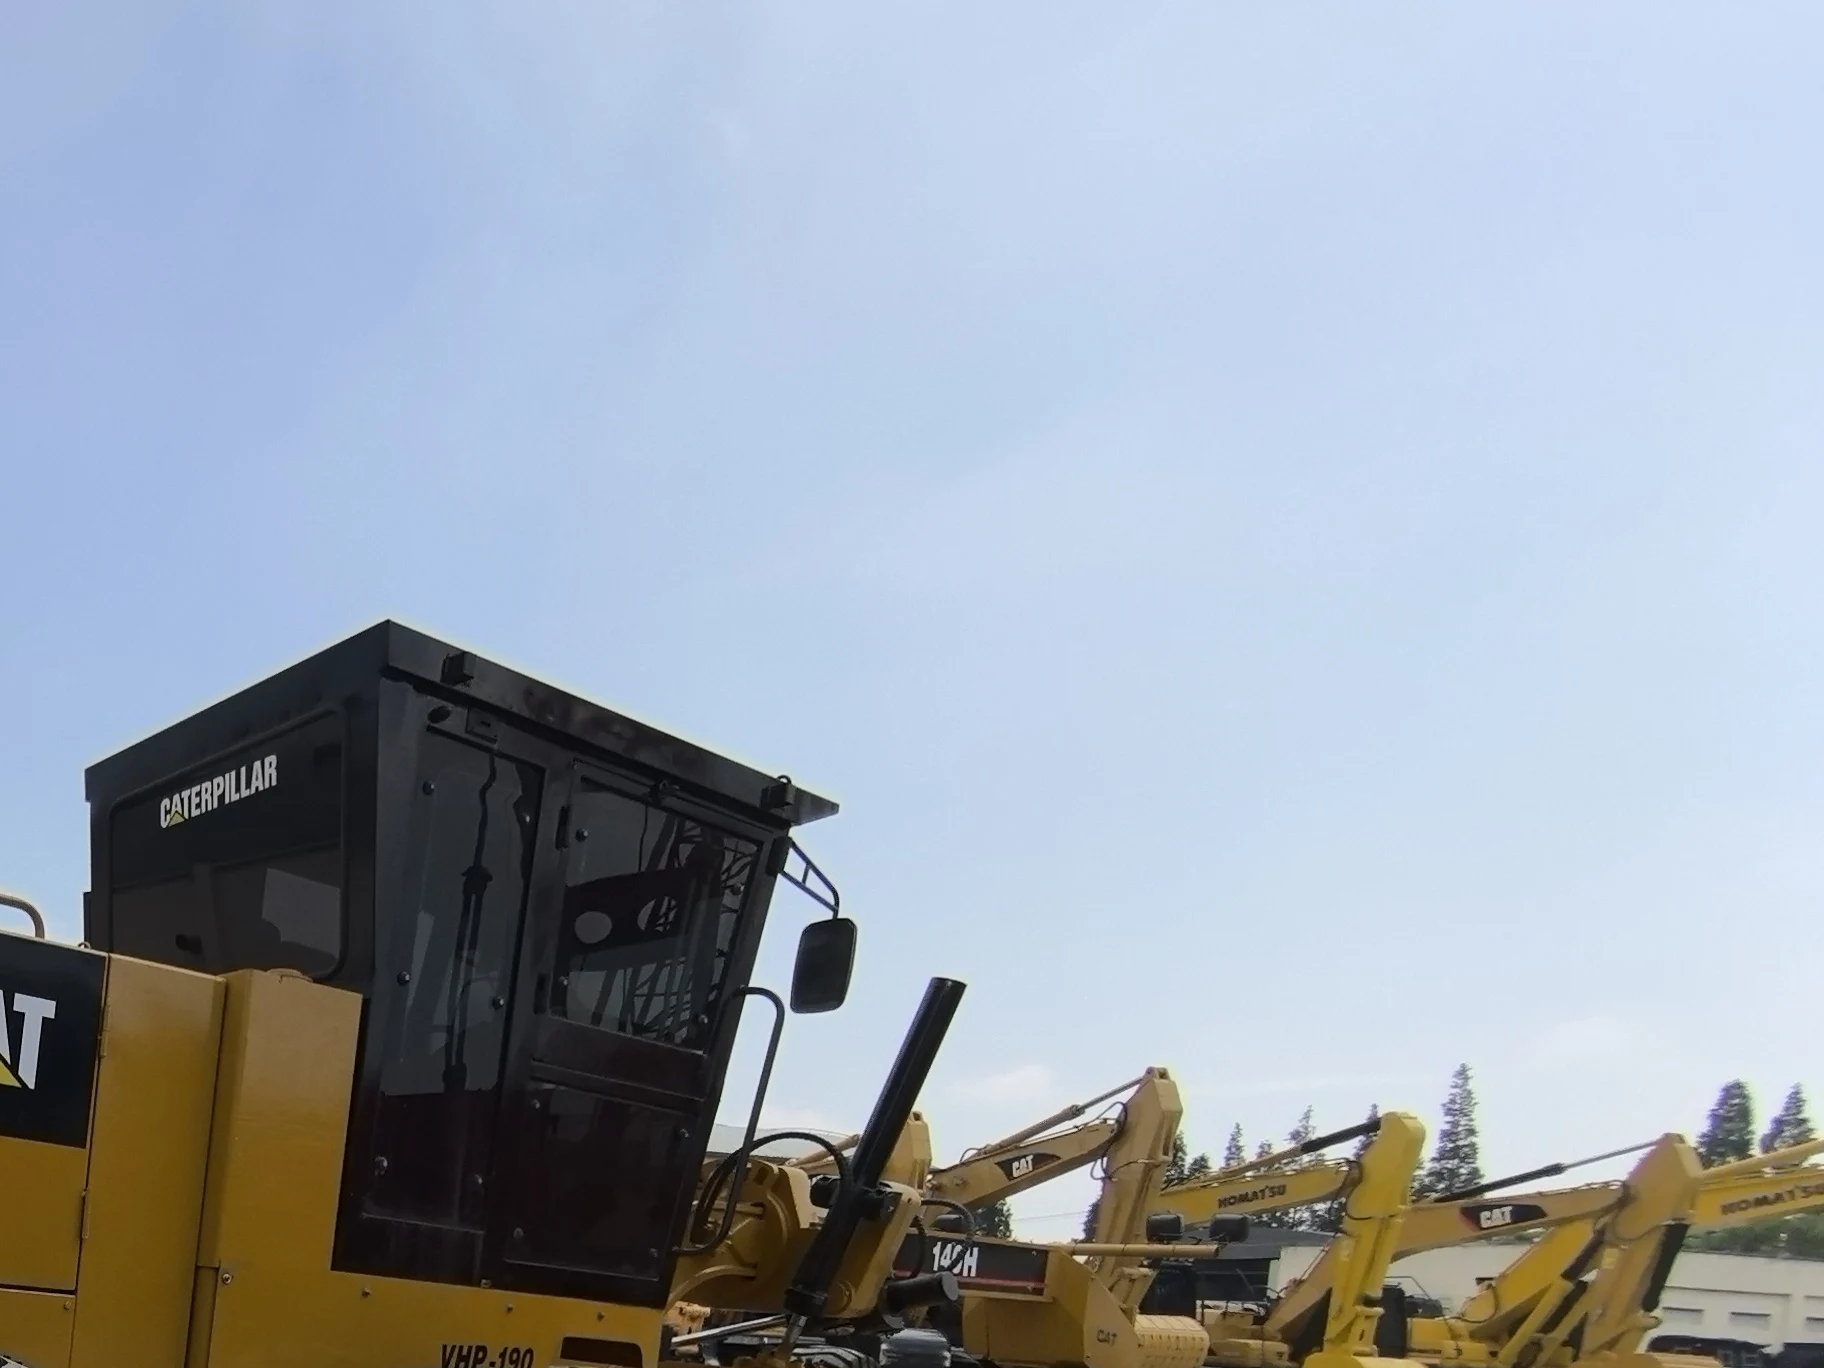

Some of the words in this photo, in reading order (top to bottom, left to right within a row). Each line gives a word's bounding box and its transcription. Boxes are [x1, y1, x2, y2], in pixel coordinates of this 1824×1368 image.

[160, 754, 277, 829] CATERPILLAR
[1012, 1154, 1034, 1178] CAT
[1218, 1184, 1286, 1209] KOMATSU
[1480, 1205, 1513, 1228] CAT
